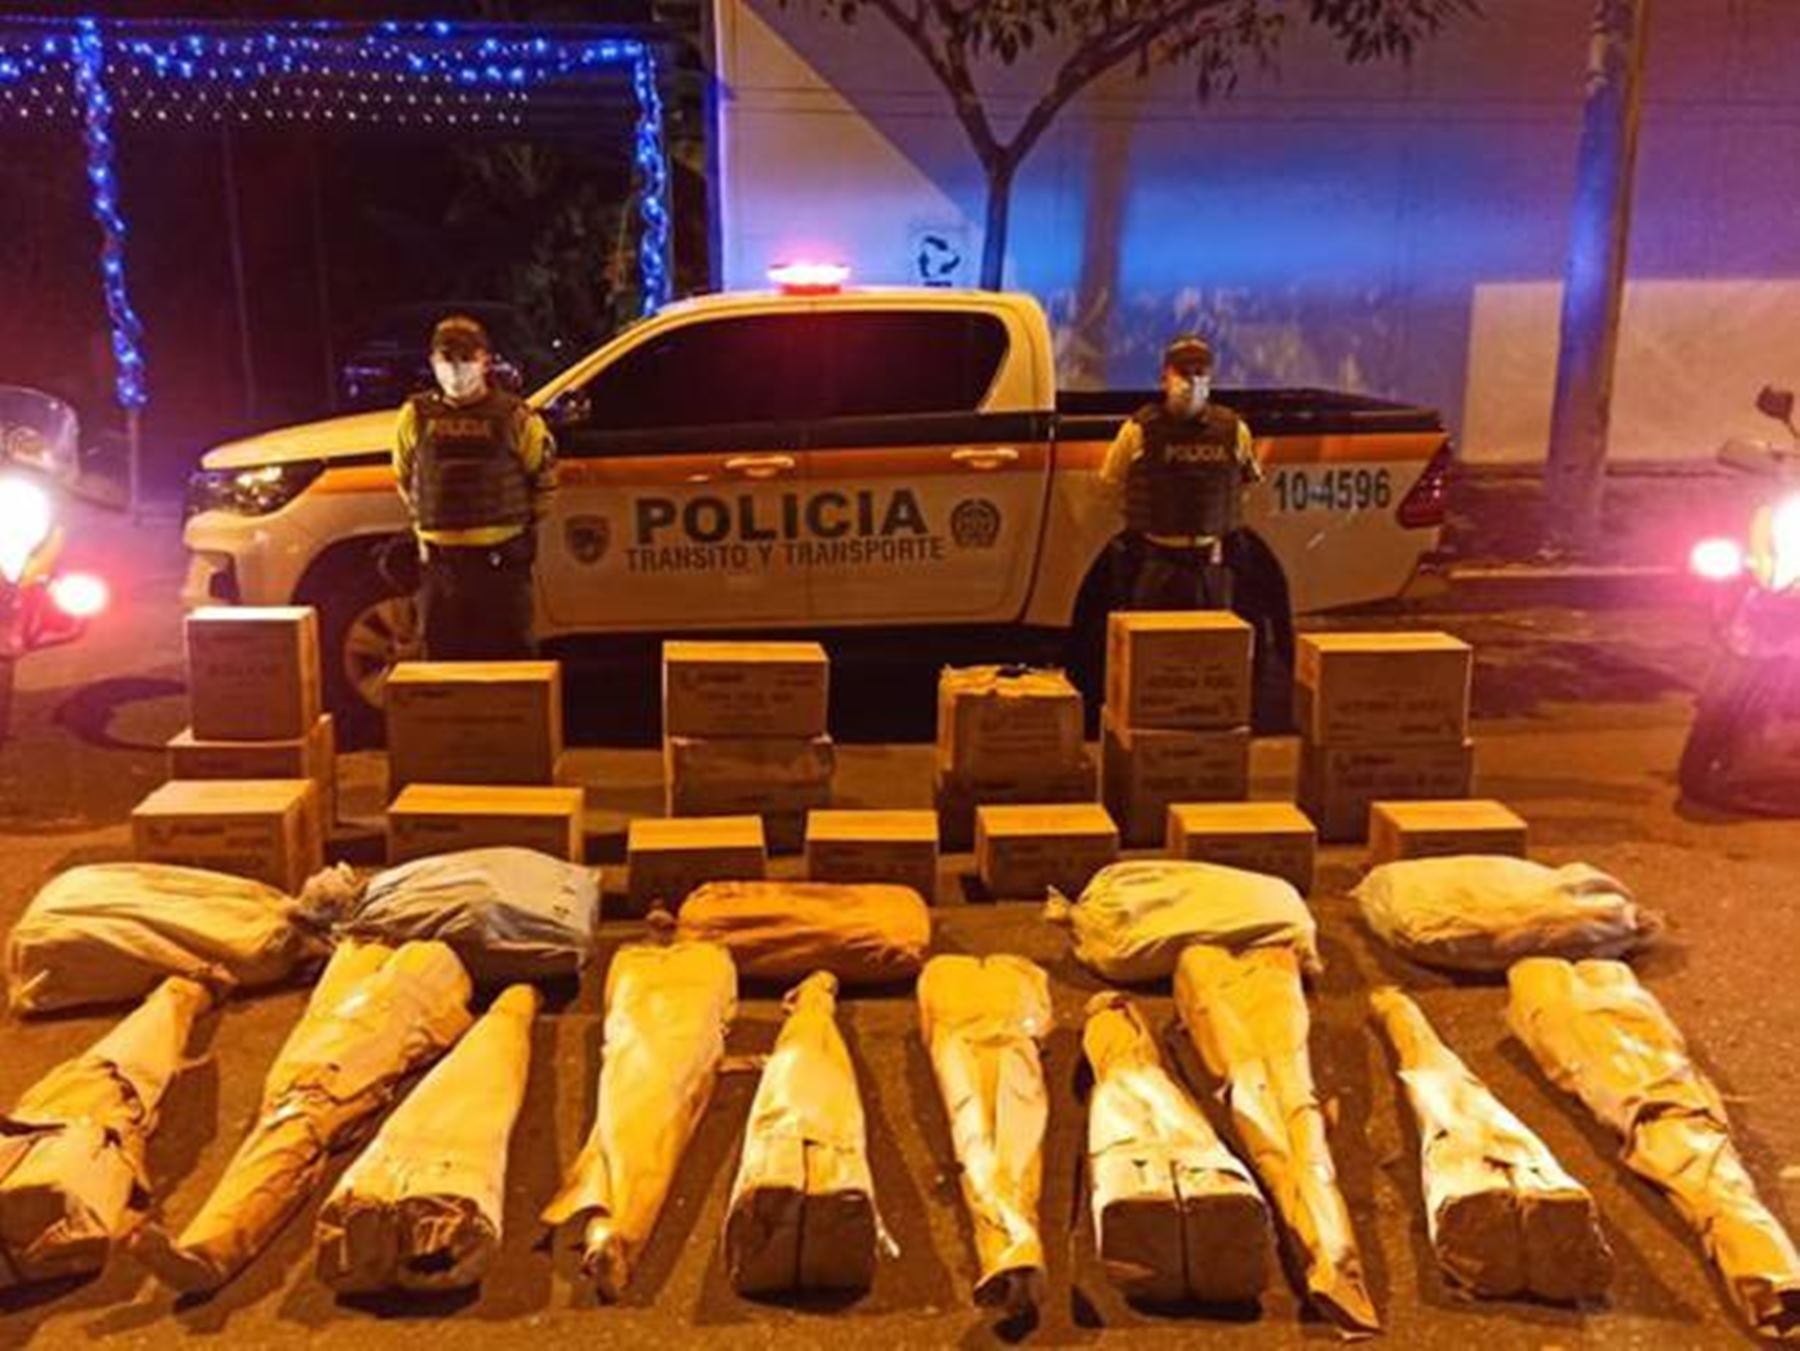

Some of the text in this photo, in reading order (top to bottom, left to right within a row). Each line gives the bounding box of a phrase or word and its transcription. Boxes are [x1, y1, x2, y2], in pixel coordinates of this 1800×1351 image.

[1273, 468, 1391, 511] 10-4596
[635, 488, 929, 545] POLICIA
[626, 536, 946, 573] TRANSITO Y TRANSPORTE
